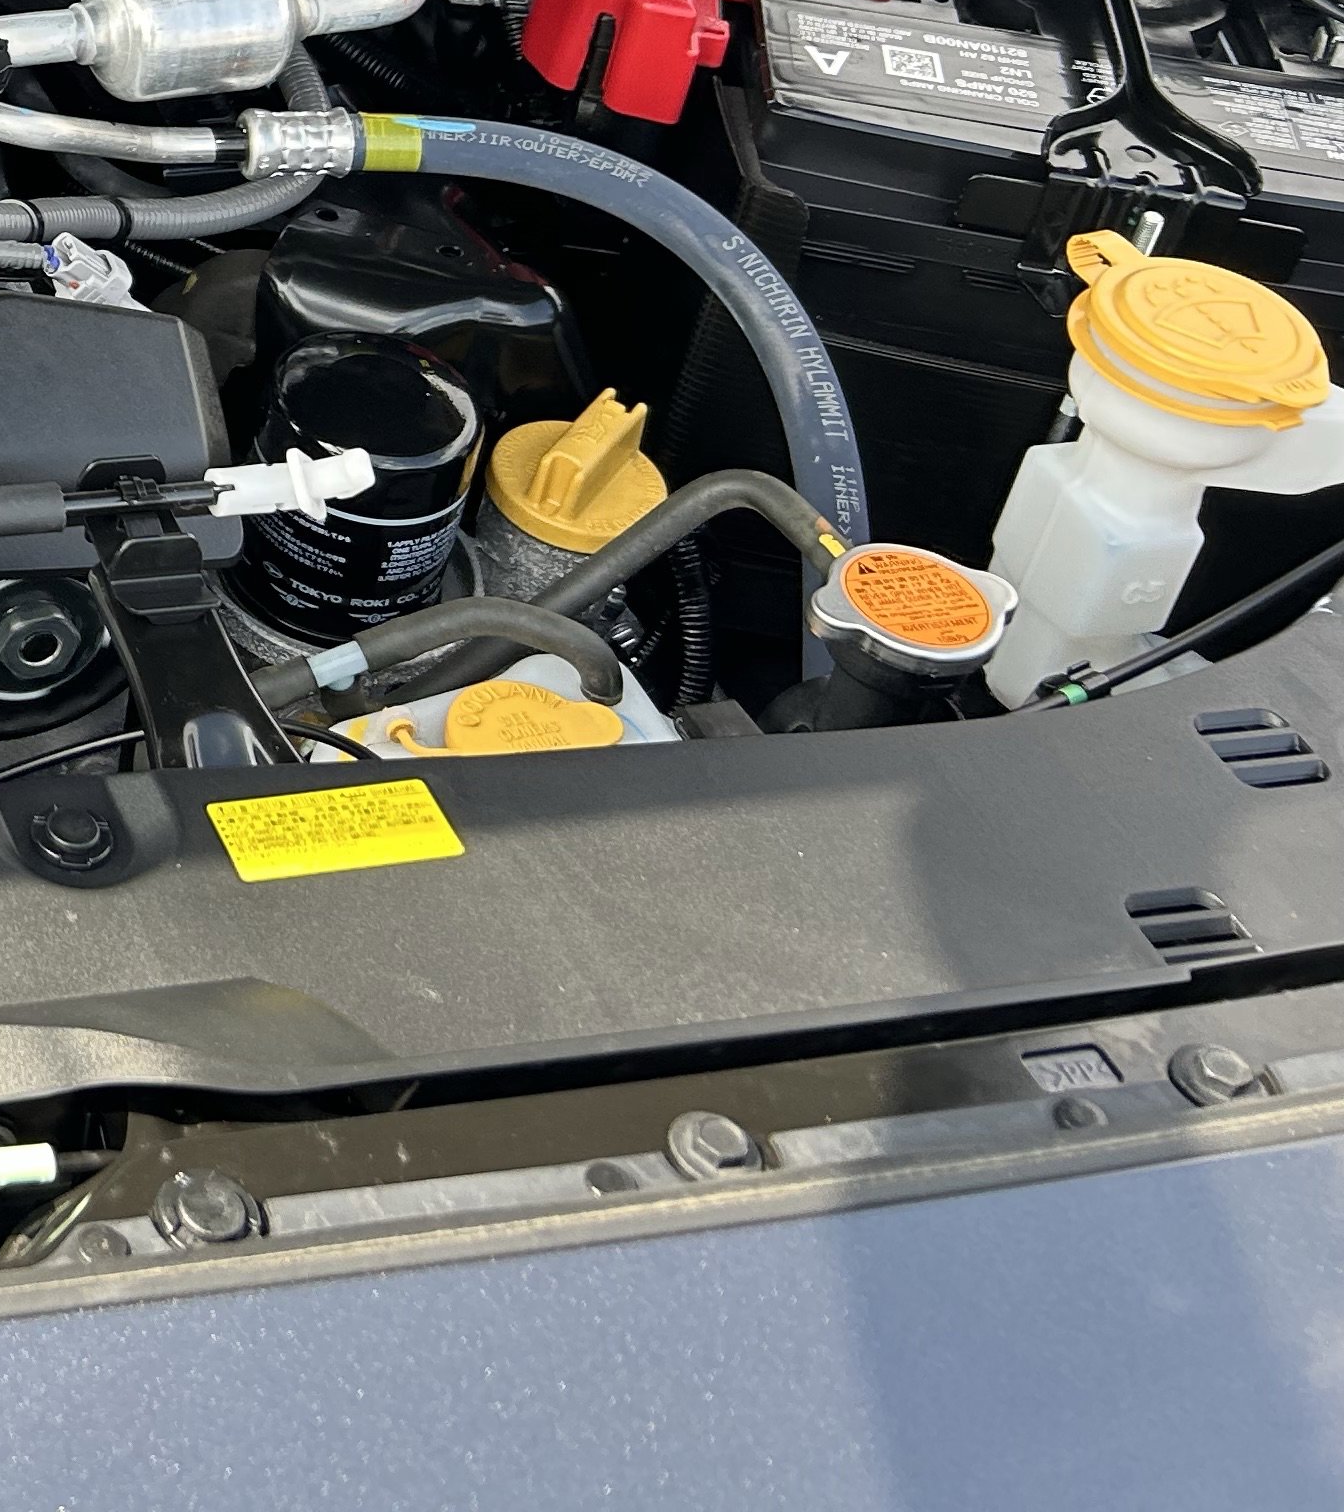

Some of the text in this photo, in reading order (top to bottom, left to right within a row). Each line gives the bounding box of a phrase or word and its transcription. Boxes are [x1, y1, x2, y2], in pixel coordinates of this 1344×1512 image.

[954, 78, 1004, 93] AMPS
[998, 65, 1032, 78] LN2
[796, 346, 849, 442] HYLAMMIT
[289, 578, 343, 604] TOKYO
[350, 598, 390, 607] ROKI
[457, 681, 569, 727] COOLANT
